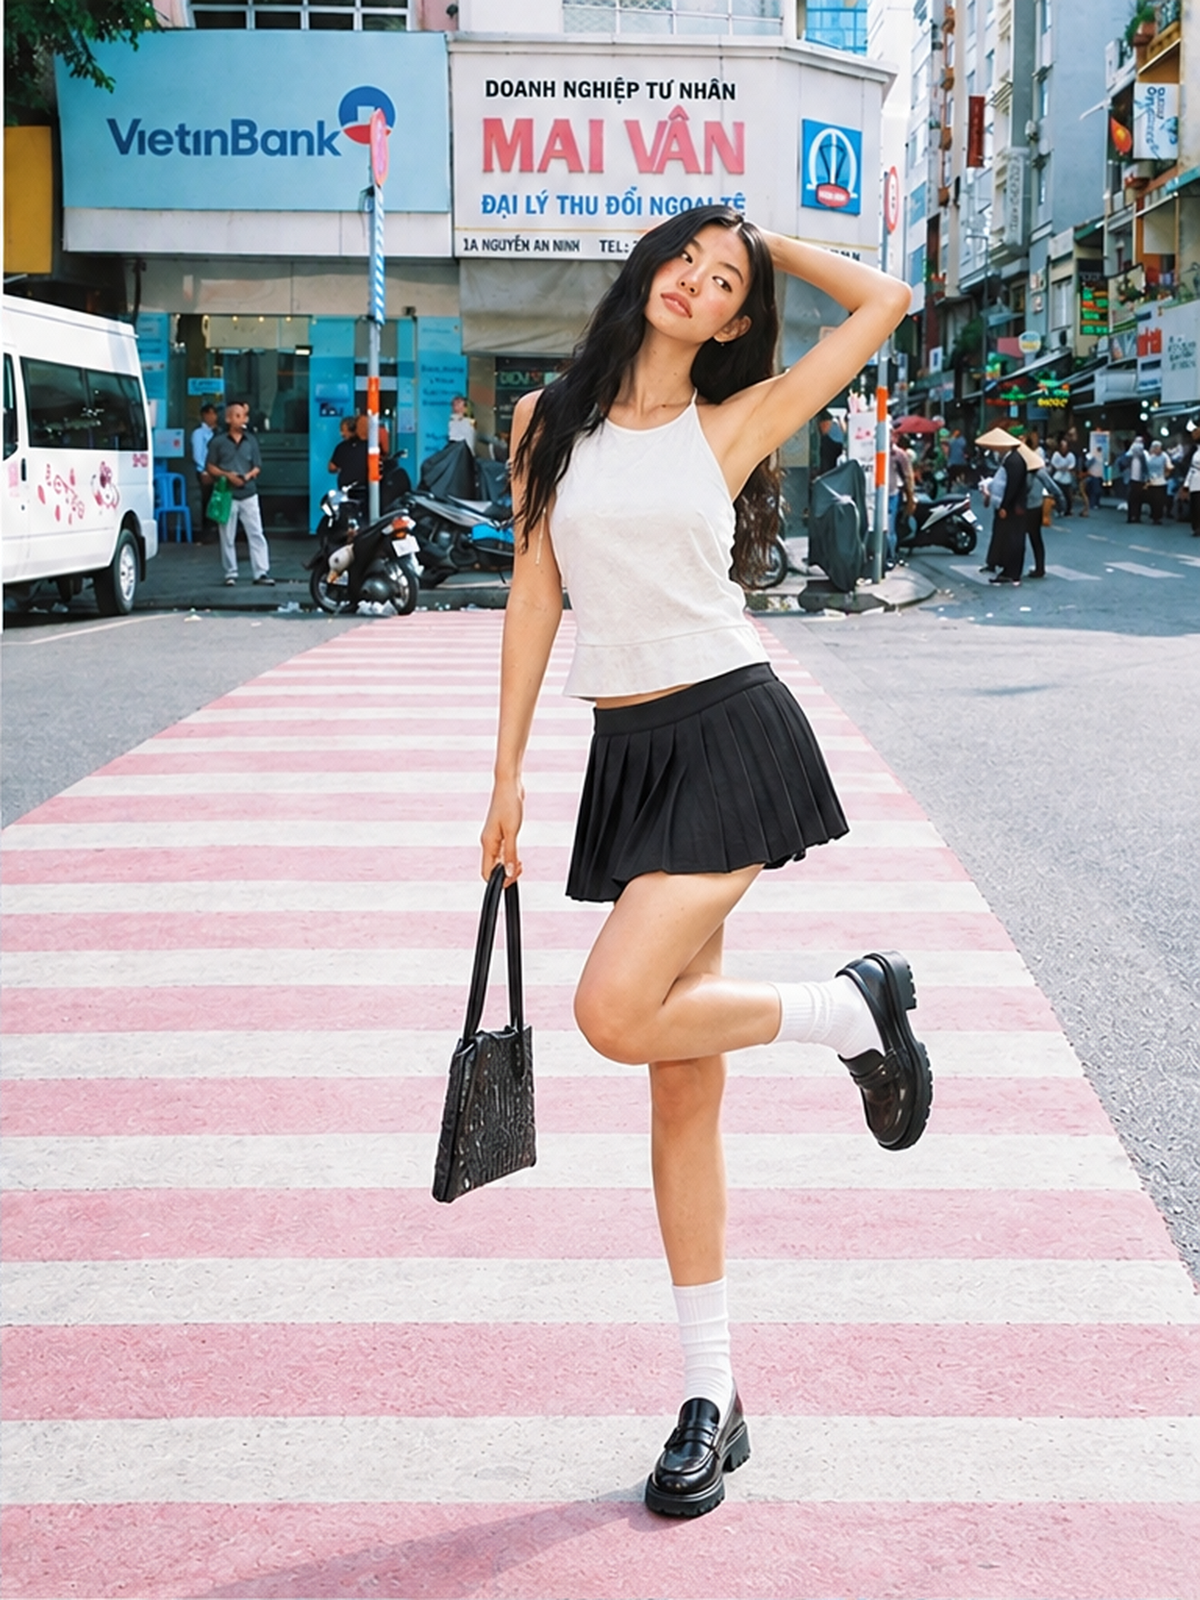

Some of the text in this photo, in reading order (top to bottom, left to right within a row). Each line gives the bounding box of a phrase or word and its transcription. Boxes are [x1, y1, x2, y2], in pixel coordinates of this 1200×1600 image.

[485, 77, 736, 105] DOANH NGHIỆP TƯ NHÂN
[106, 117, 343, 157] VietinBank
[482, 104, 745, 175] MAI VÂN
[481, 194, 518, 219] ĐẠI
[525, 189, 549, 215] LÝ
[556, 194, 598, 216] THU
[463, 238, 479, 252] 1A
[533, 239, 550, 252] AN
[599, 239, 629, 253] TEL:
